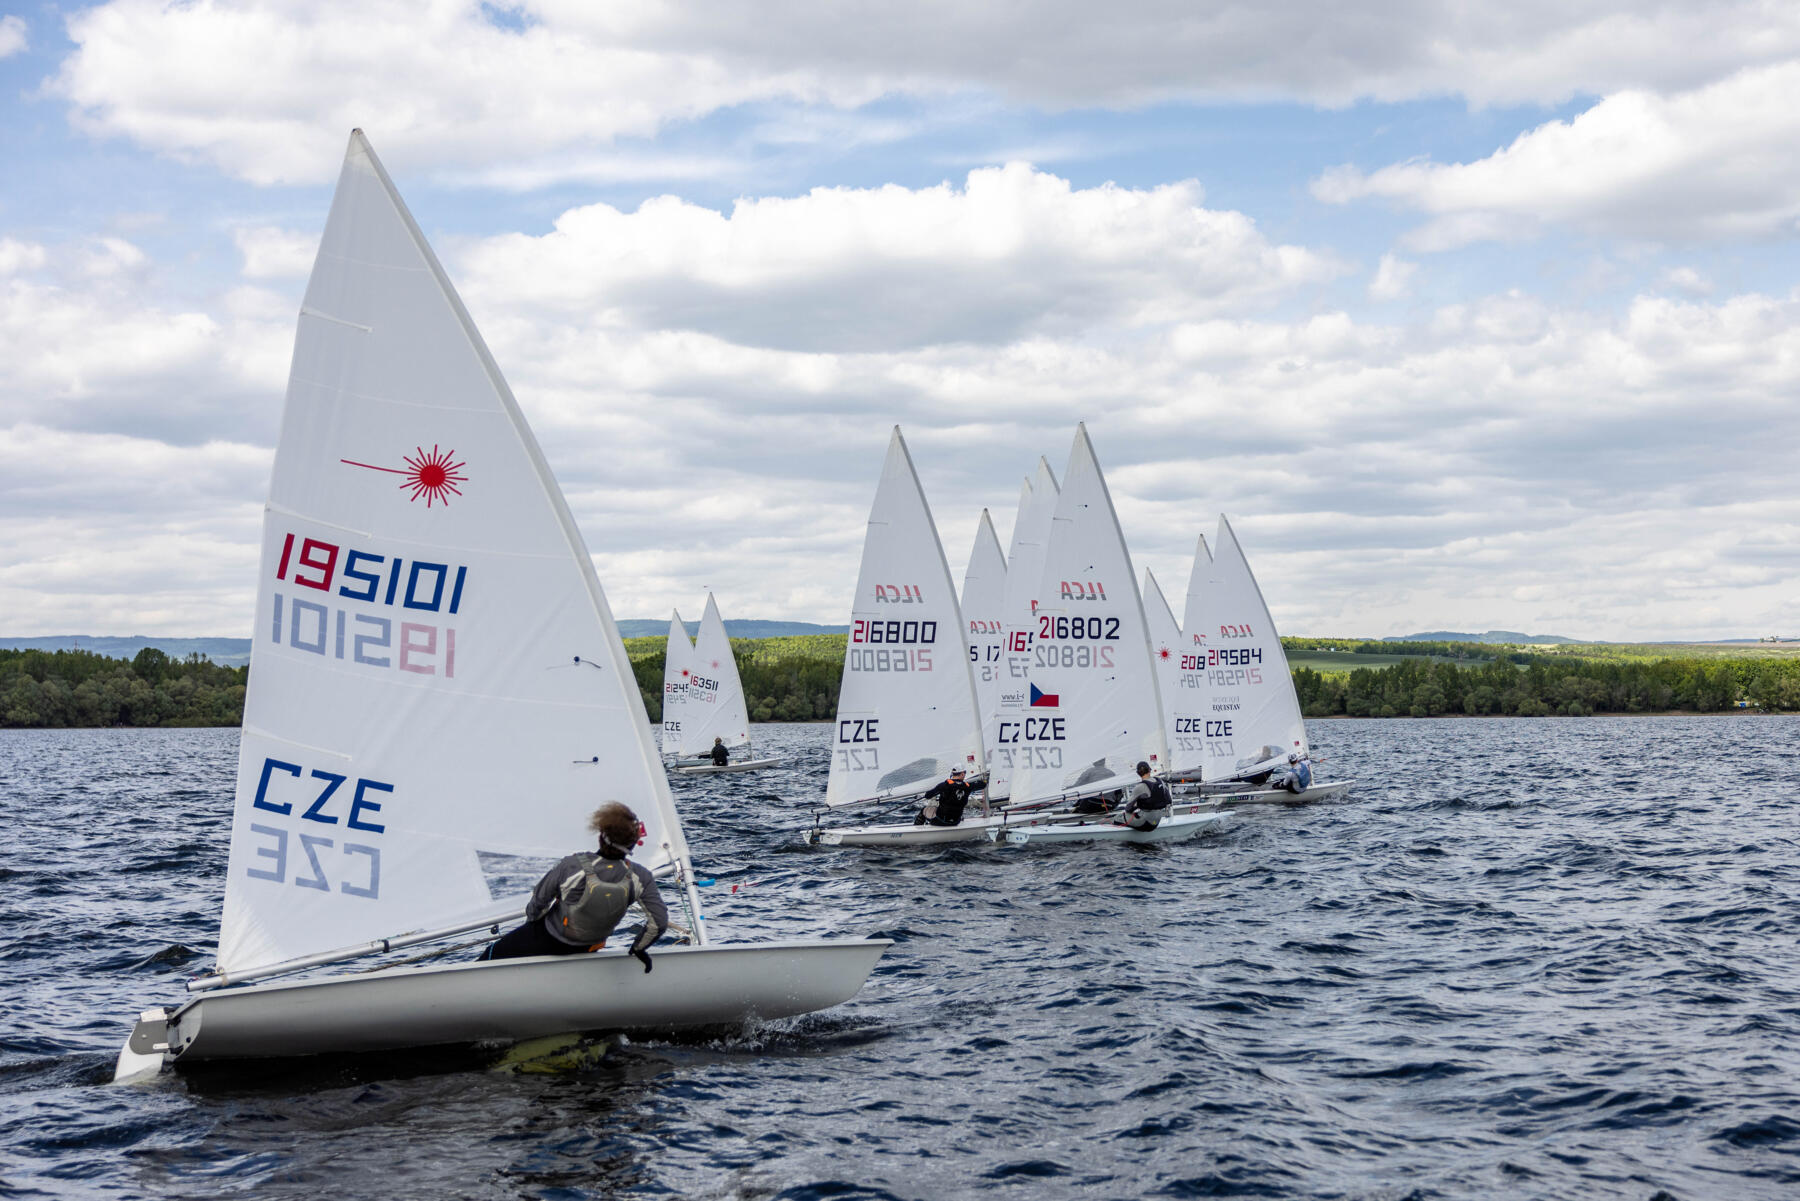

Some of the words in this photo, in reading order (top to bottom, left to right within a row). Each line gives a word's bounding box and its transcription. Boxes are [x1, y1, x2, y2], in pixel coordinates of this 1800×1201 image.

[276, 533, 467, 614] 195101
[853, 620, 937, 643] 216800
[1039, 616, 1120, 640] 216802
[1208, 648, 1262, 666] 219584
[690, 675, 719, 691] 163511
[665, 721, 681, 731] CZE
[840, 719, 880, 743] CZE
[1025, 718, 1066, 741] CZE
[1176, 718, 1201, 733] CZE
[1206, 720, 1233, 737] CZE
[253, 757, 394, 834] CZE
